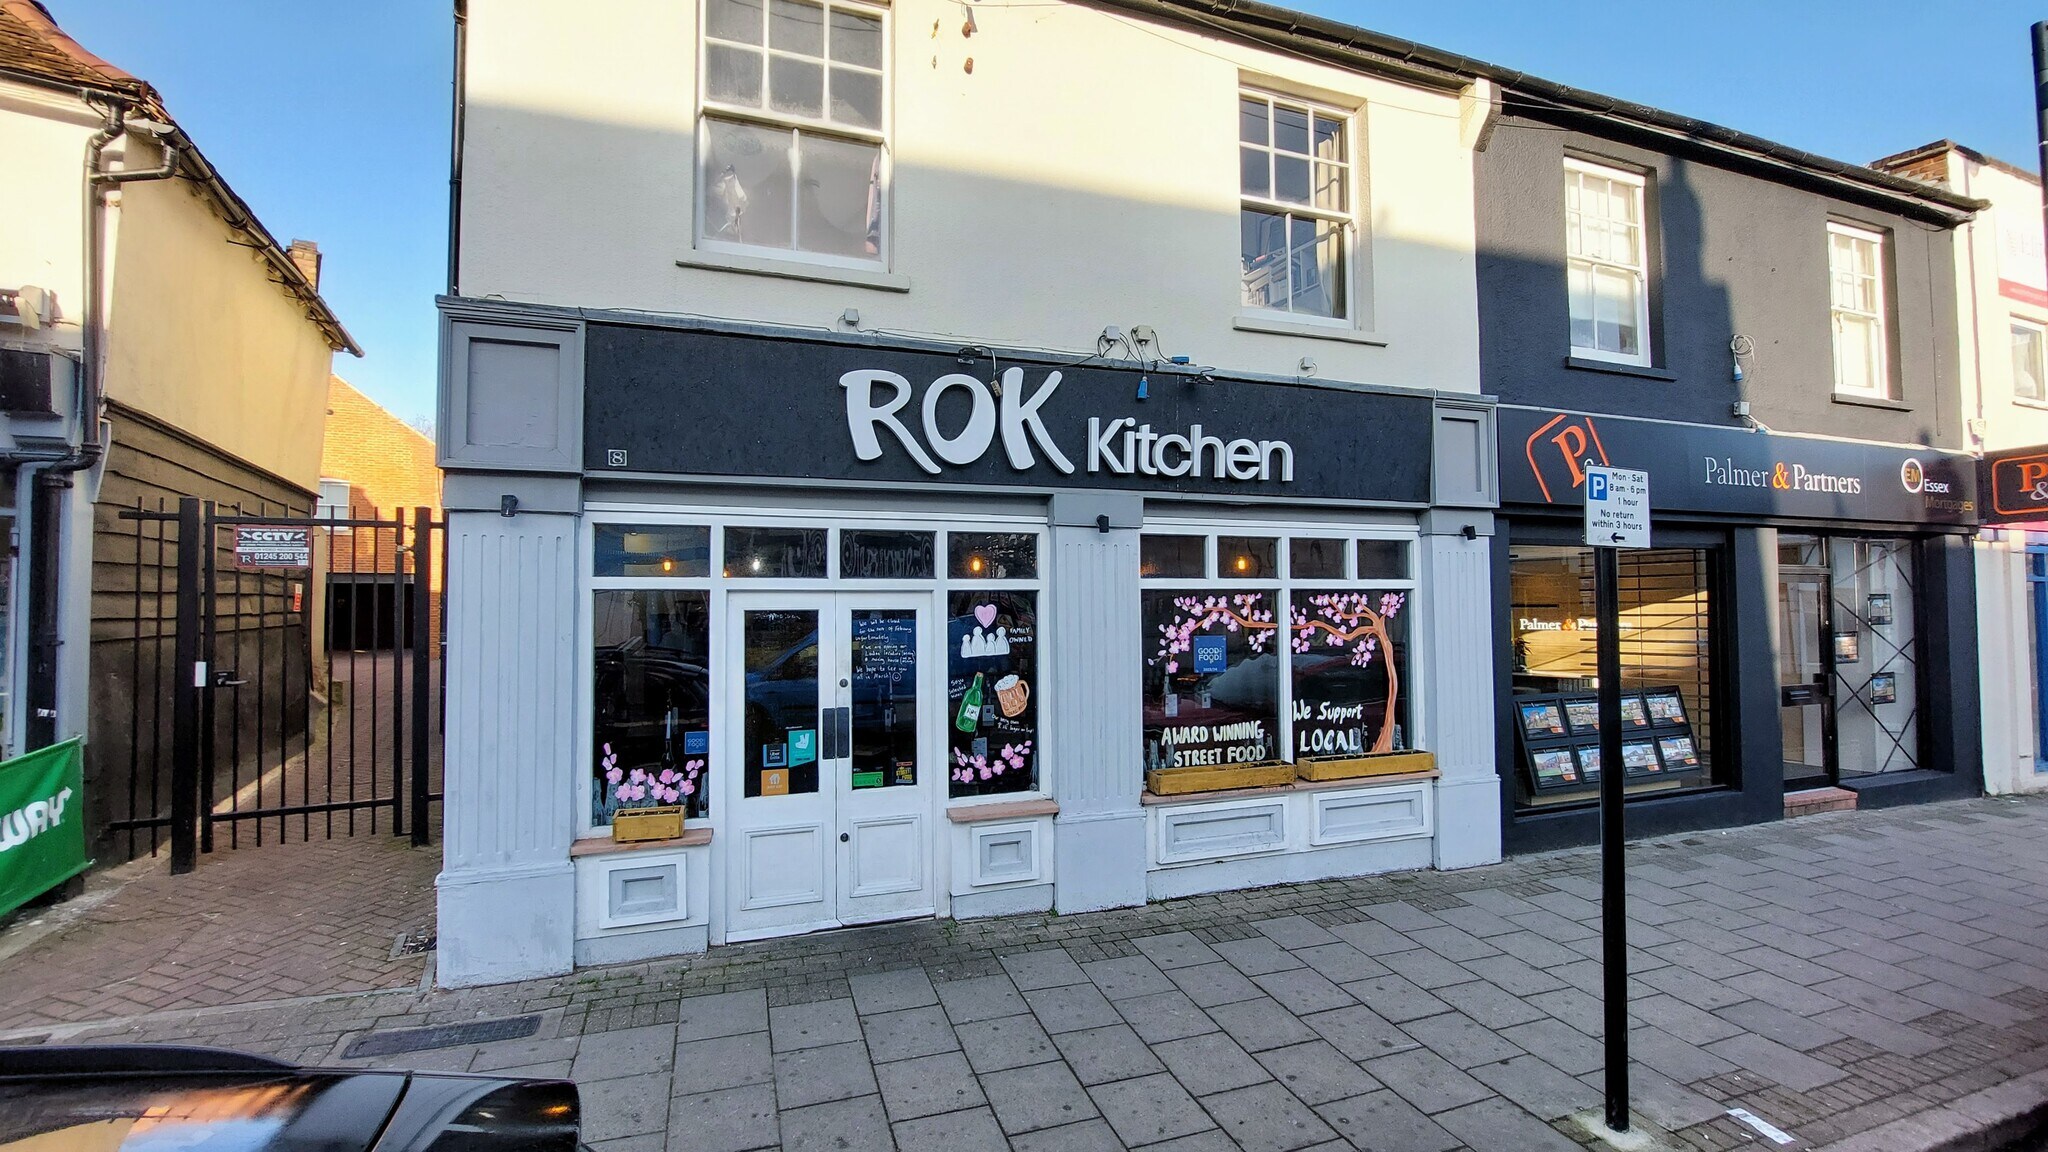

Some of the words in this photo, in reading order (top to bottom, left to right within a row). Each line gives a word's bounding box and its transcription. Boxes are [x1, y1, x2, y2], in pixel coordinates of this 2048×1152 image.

[838, 366, 1075, 474] ROK
[1087, 417, 1294, 482] Kitchen
[612, 451, 623, 464] 8
[1611, 472, 1627, 481] Mon
[1631, 474, 1643, 482] Sat
[1704, 456, 1769, 488] Palmer
[1772, 462, 1790, 490] &
[1792, 463, 1861, 494] Partners
[1905, 468, 1920, 482] EM
[1924, 479, 1950, 493] Essex
[1622, 498, 1638, 506] hour
[1925, 495, 1974, 514] Mortgages
[1600, 509, 1611, 517] No
[1613, 511, 1634, 519] return
[1592, 520, 1614, 528] within
[1616, 521, 1621, 529] 3
[1623, 522, 1643, 530] hours
[251, 531, 294, 541] CCTV
[254, 552, 278, 560] 01245
[1010, 626, 1031, 634] FAMILY
[1519, 618, 1562, 630] Palmer
[1292, 699, 1311, 722] We
[1317, 700, 1364, 725] Support
[1161, 724, 1208, 746] AWARD
[1212, 720, 1265, 742] WINNING
[1299, 728, 1361, 752] LOCAL
[1173, 748, 1222, 768] STREET
[1227, 744, 1266, 763] FOOD
